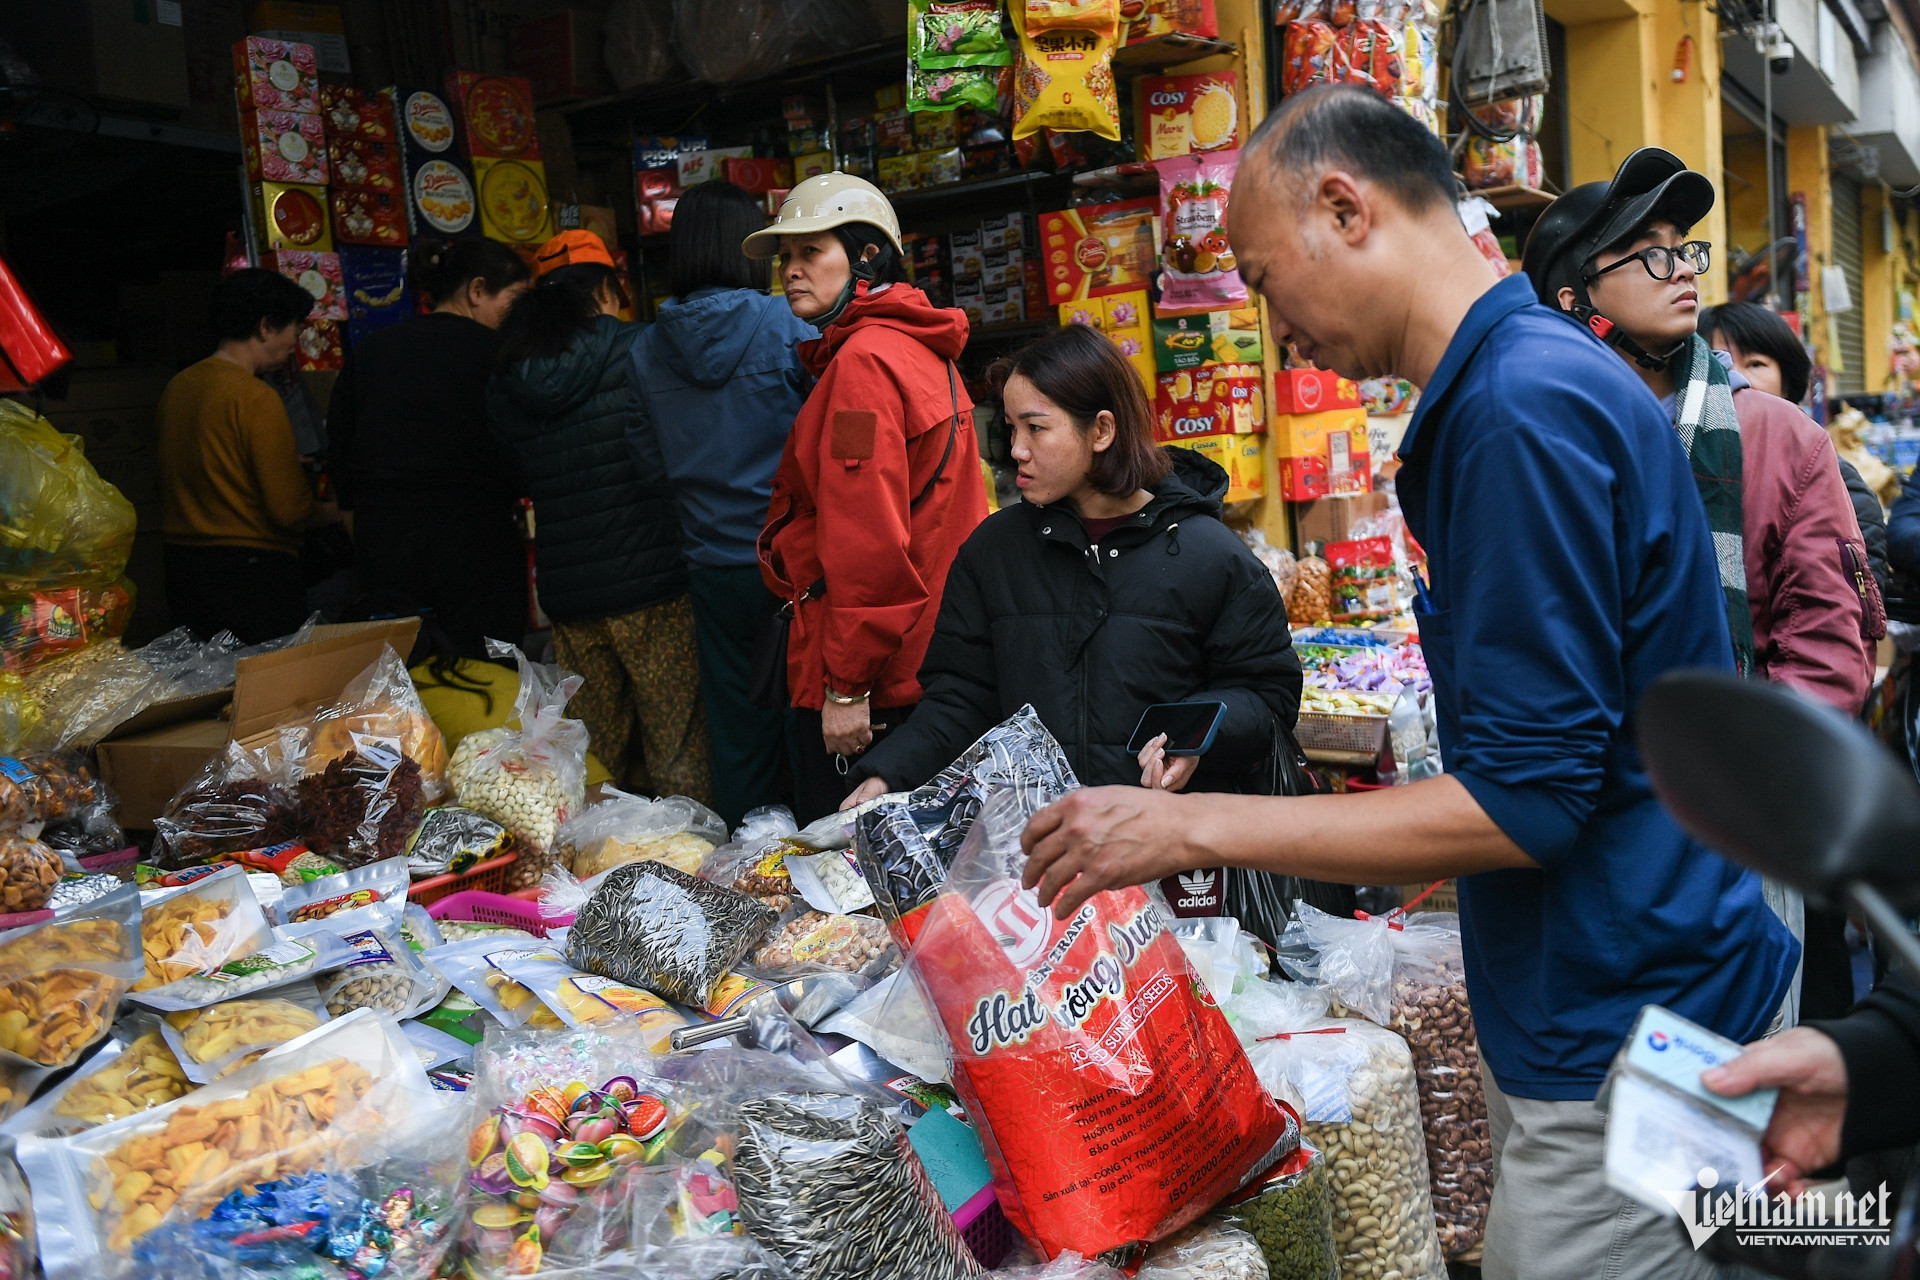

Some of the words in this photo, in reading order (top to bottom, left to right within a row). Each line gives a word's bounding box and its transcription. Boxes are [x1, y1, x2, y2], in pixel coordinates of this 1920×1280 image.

[1150, 91, 1188, 106] COSY
[641, 149, 678, 161] PICK
[679, 140, 708, 152] UP!
[682, 157, 704, 174] AFC
[1176, 212, 1216, 225] Strawberry
[1232, 386, 1249, 398] COSY
[1174, 416, 1215, 435] COSY
[1191, 441, 1218, 450] Custas
[1178, 895, 1217, 908] adidas
[1050, 905, 1095, 962] TRANG
[1147, 973, 1174, 1003] SEEDS
[969, 986, 1044, 1051] Hạt
[1069, 1093, 1104, 1114] THÀNH
[1075, 1112, 1098, 1128] Thời
[1100, 1103, 1118, 1118] hạn
[1119, 1096, 1132, 1108] sử
[1082, 1123, 1115, 1143] Hướng
[1116, 1112, 1135, 1128] dẫn
[1135, 1103, 1148, 1116] sử
[1088, 1140, 1110, 1157] Bảo
[1111, 1128, 1137, 1148] quản:
[1139, 1117, 1154, 1132] Nơi
[1153, 1108, 1169, 1122] khô
[1042, 1190, 1059, 1202] Sản
[1060, 1182, 1079, 1197] xuất
[1079, 1176, 1094, 1191] tại:
[1093, 1163, 1121, 1181] CÔNG
[1121, 1156, 1133, 1169] TY
[1134, 1142, 1158, 1160] TNHH
[1157, 1128, 1173, 1146] SẢN
[1193, 1099, 1205, 1116] CHẾ
[1171, 1153, 1183, 1166] Hà
[1098, 1180, 1117, 1195] Địa
[1118, 1169, 1136, 1186] chỉ:
[1136, 1158, 1158, 1174] Thôn
[1158, 1140, 1180, 1162] Quyết
[1158, 1176, 1170, 1190] Số
[1170, 1161, 1195, 1182] CBCL:
[1169, 1182, 1189, 1204] ISO
[1189, 1134, 1242, 1187] 22000:2018
